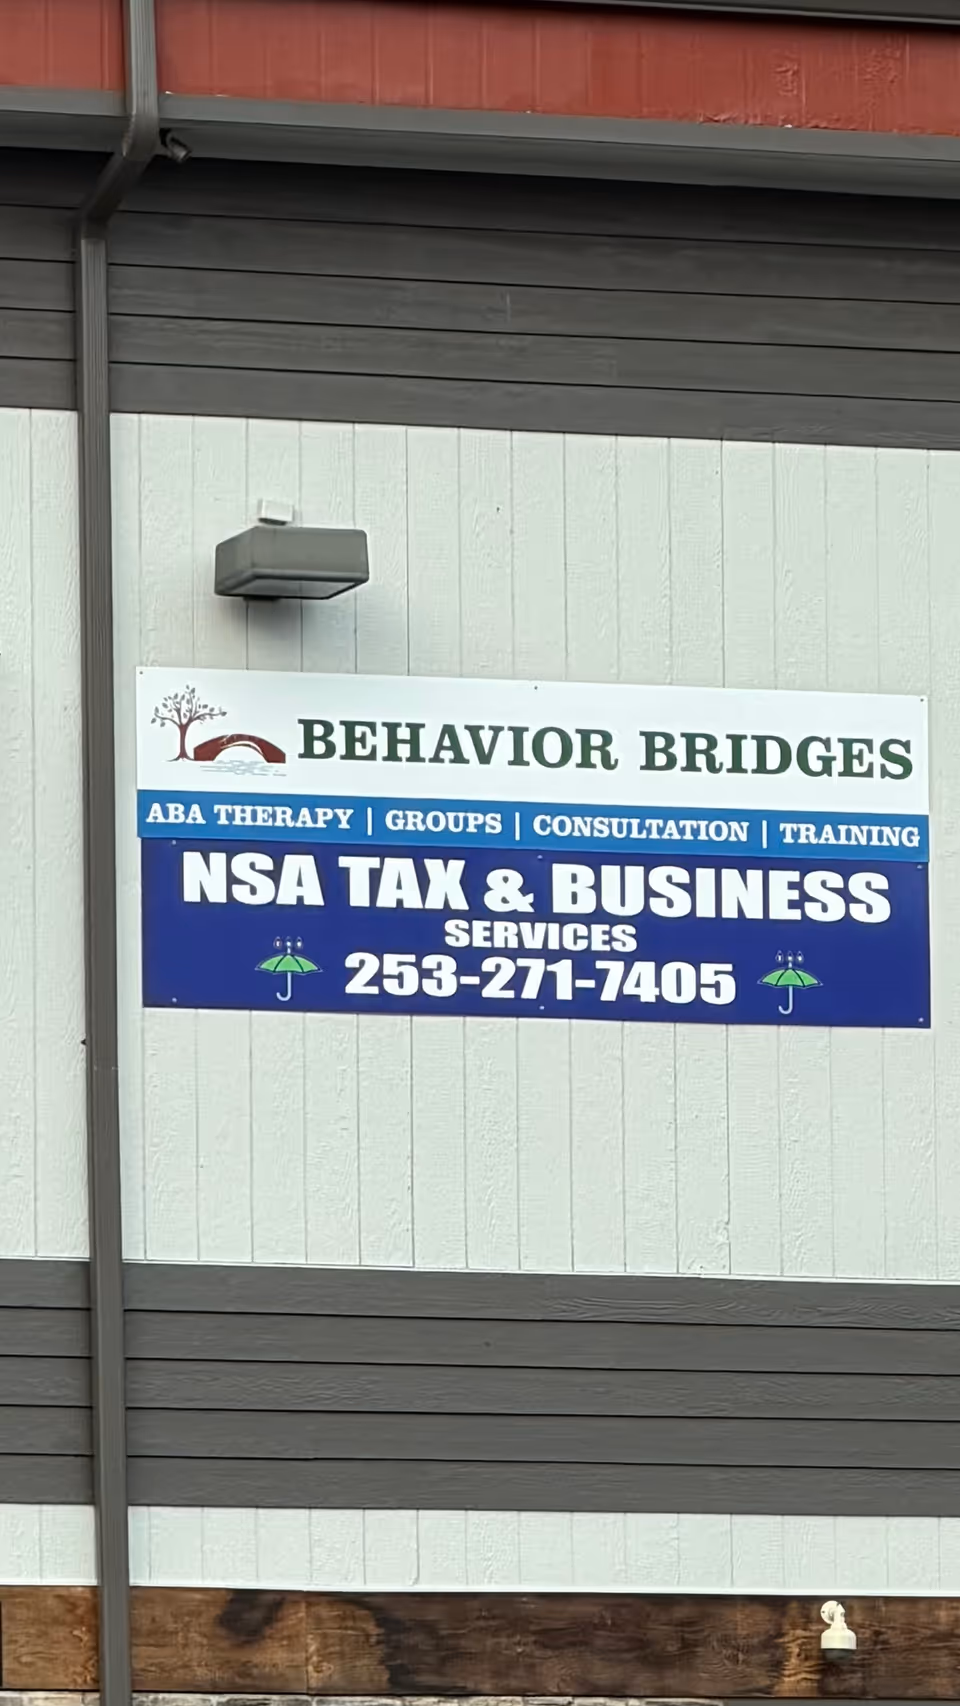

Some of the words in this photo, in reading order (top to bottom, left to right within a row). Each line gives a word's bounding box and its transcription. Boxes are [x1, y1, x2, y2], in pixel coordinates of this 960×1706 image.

[298, 719, 618, 770] BEHAVIOR
[640, 731, 912, 779] BRIDGES
[146, 803, 206, 824] ABA
[214, 805, 353, 829] THERAPY
[386, 810, 502, 834] GROUPS
[533, 815, 749, 842] CONSULTATION
[780, 823, 920, 848] TRAINING
[183, 852, 324, 905] NSA
[339, 856, 469, 910] TAX
[484, 869, 534, 913] &
[552, 864, 891, 923] BUSINESS
[445, 920, 637, 952] SERVICES
[345, 953, 737, 1005] 253-271-7405
